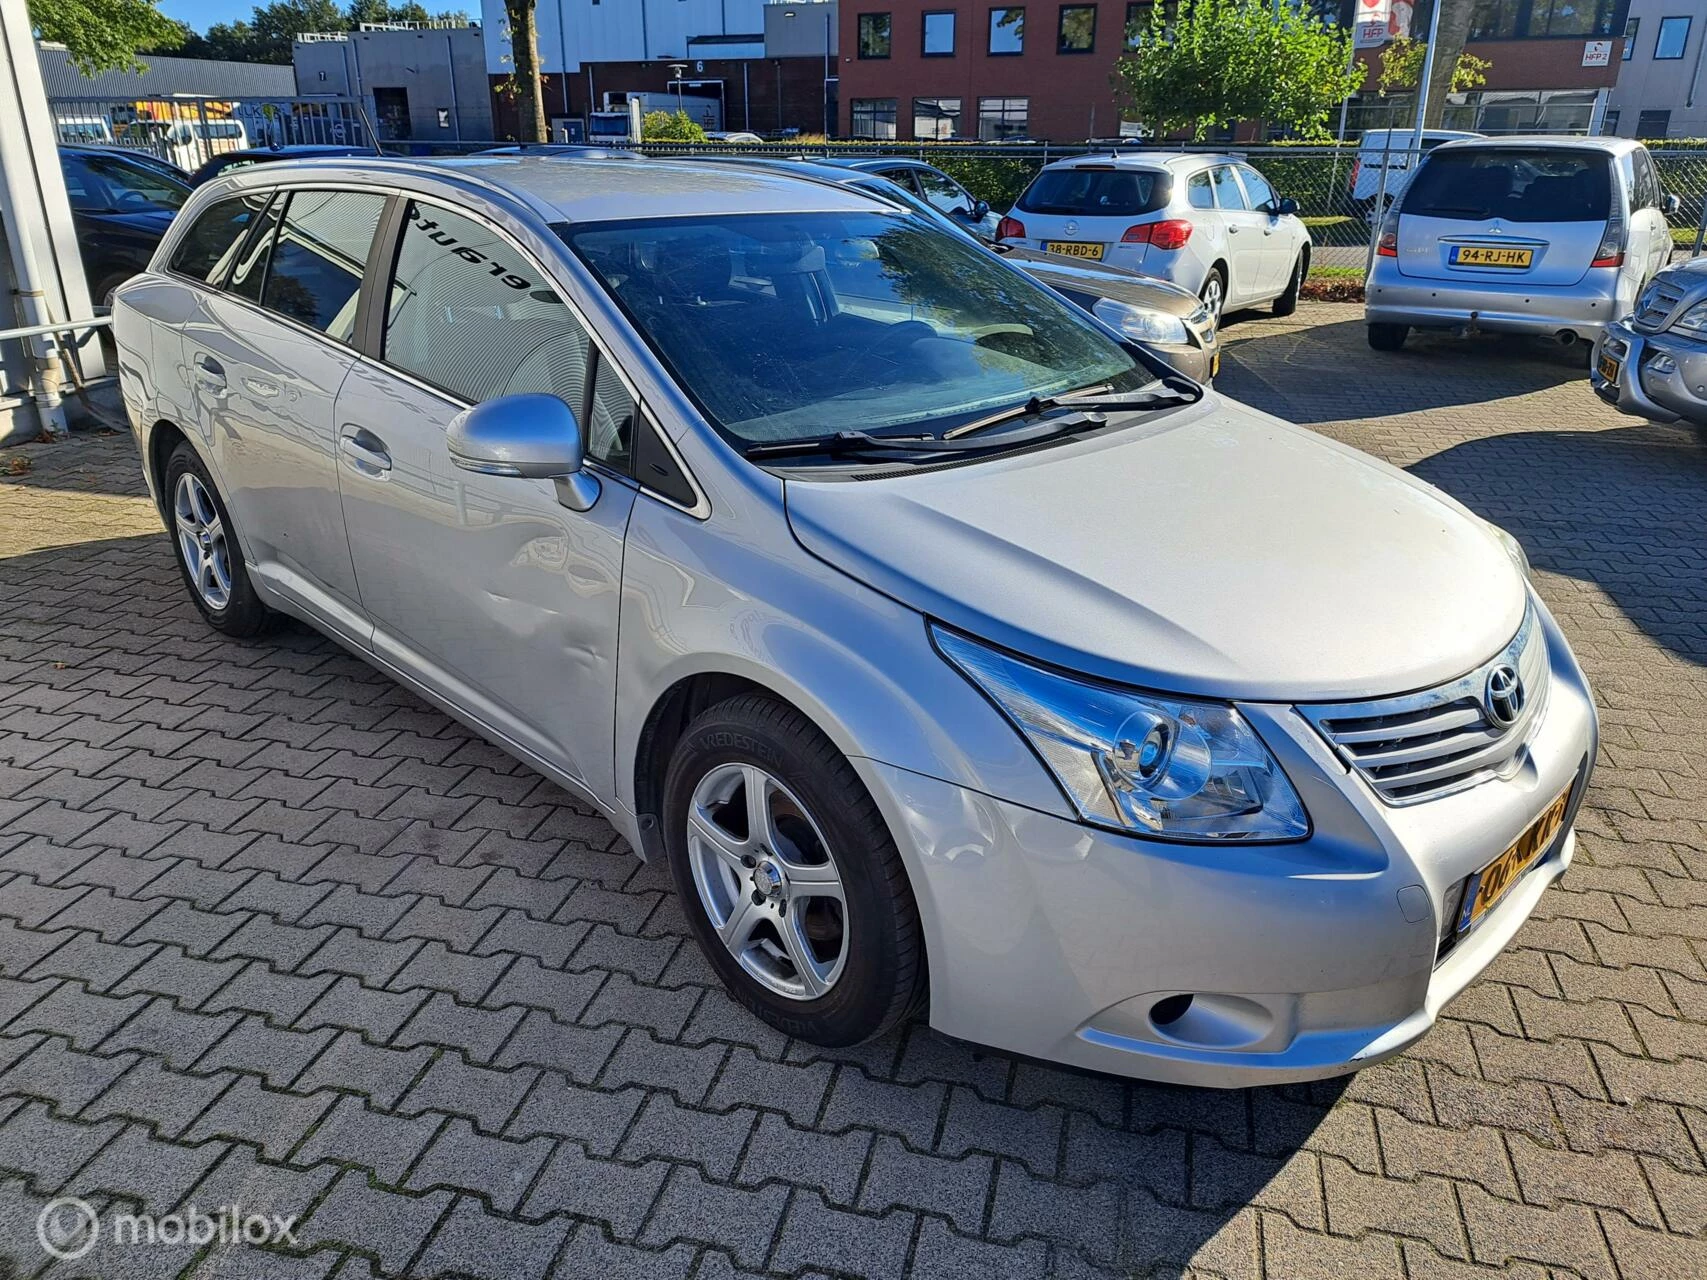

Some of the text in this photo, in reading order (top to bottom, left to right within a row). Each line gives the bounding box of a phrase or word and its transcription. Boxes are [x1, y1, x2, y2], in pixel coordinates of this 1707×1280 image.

[1362, 28, 1384, 38] HFP
[696, 61, 704, 73] 6
[1048, 244, 1099, 257] 38-RBD-6
[1462, 249, 1526, 264] 94-RJ-HK
